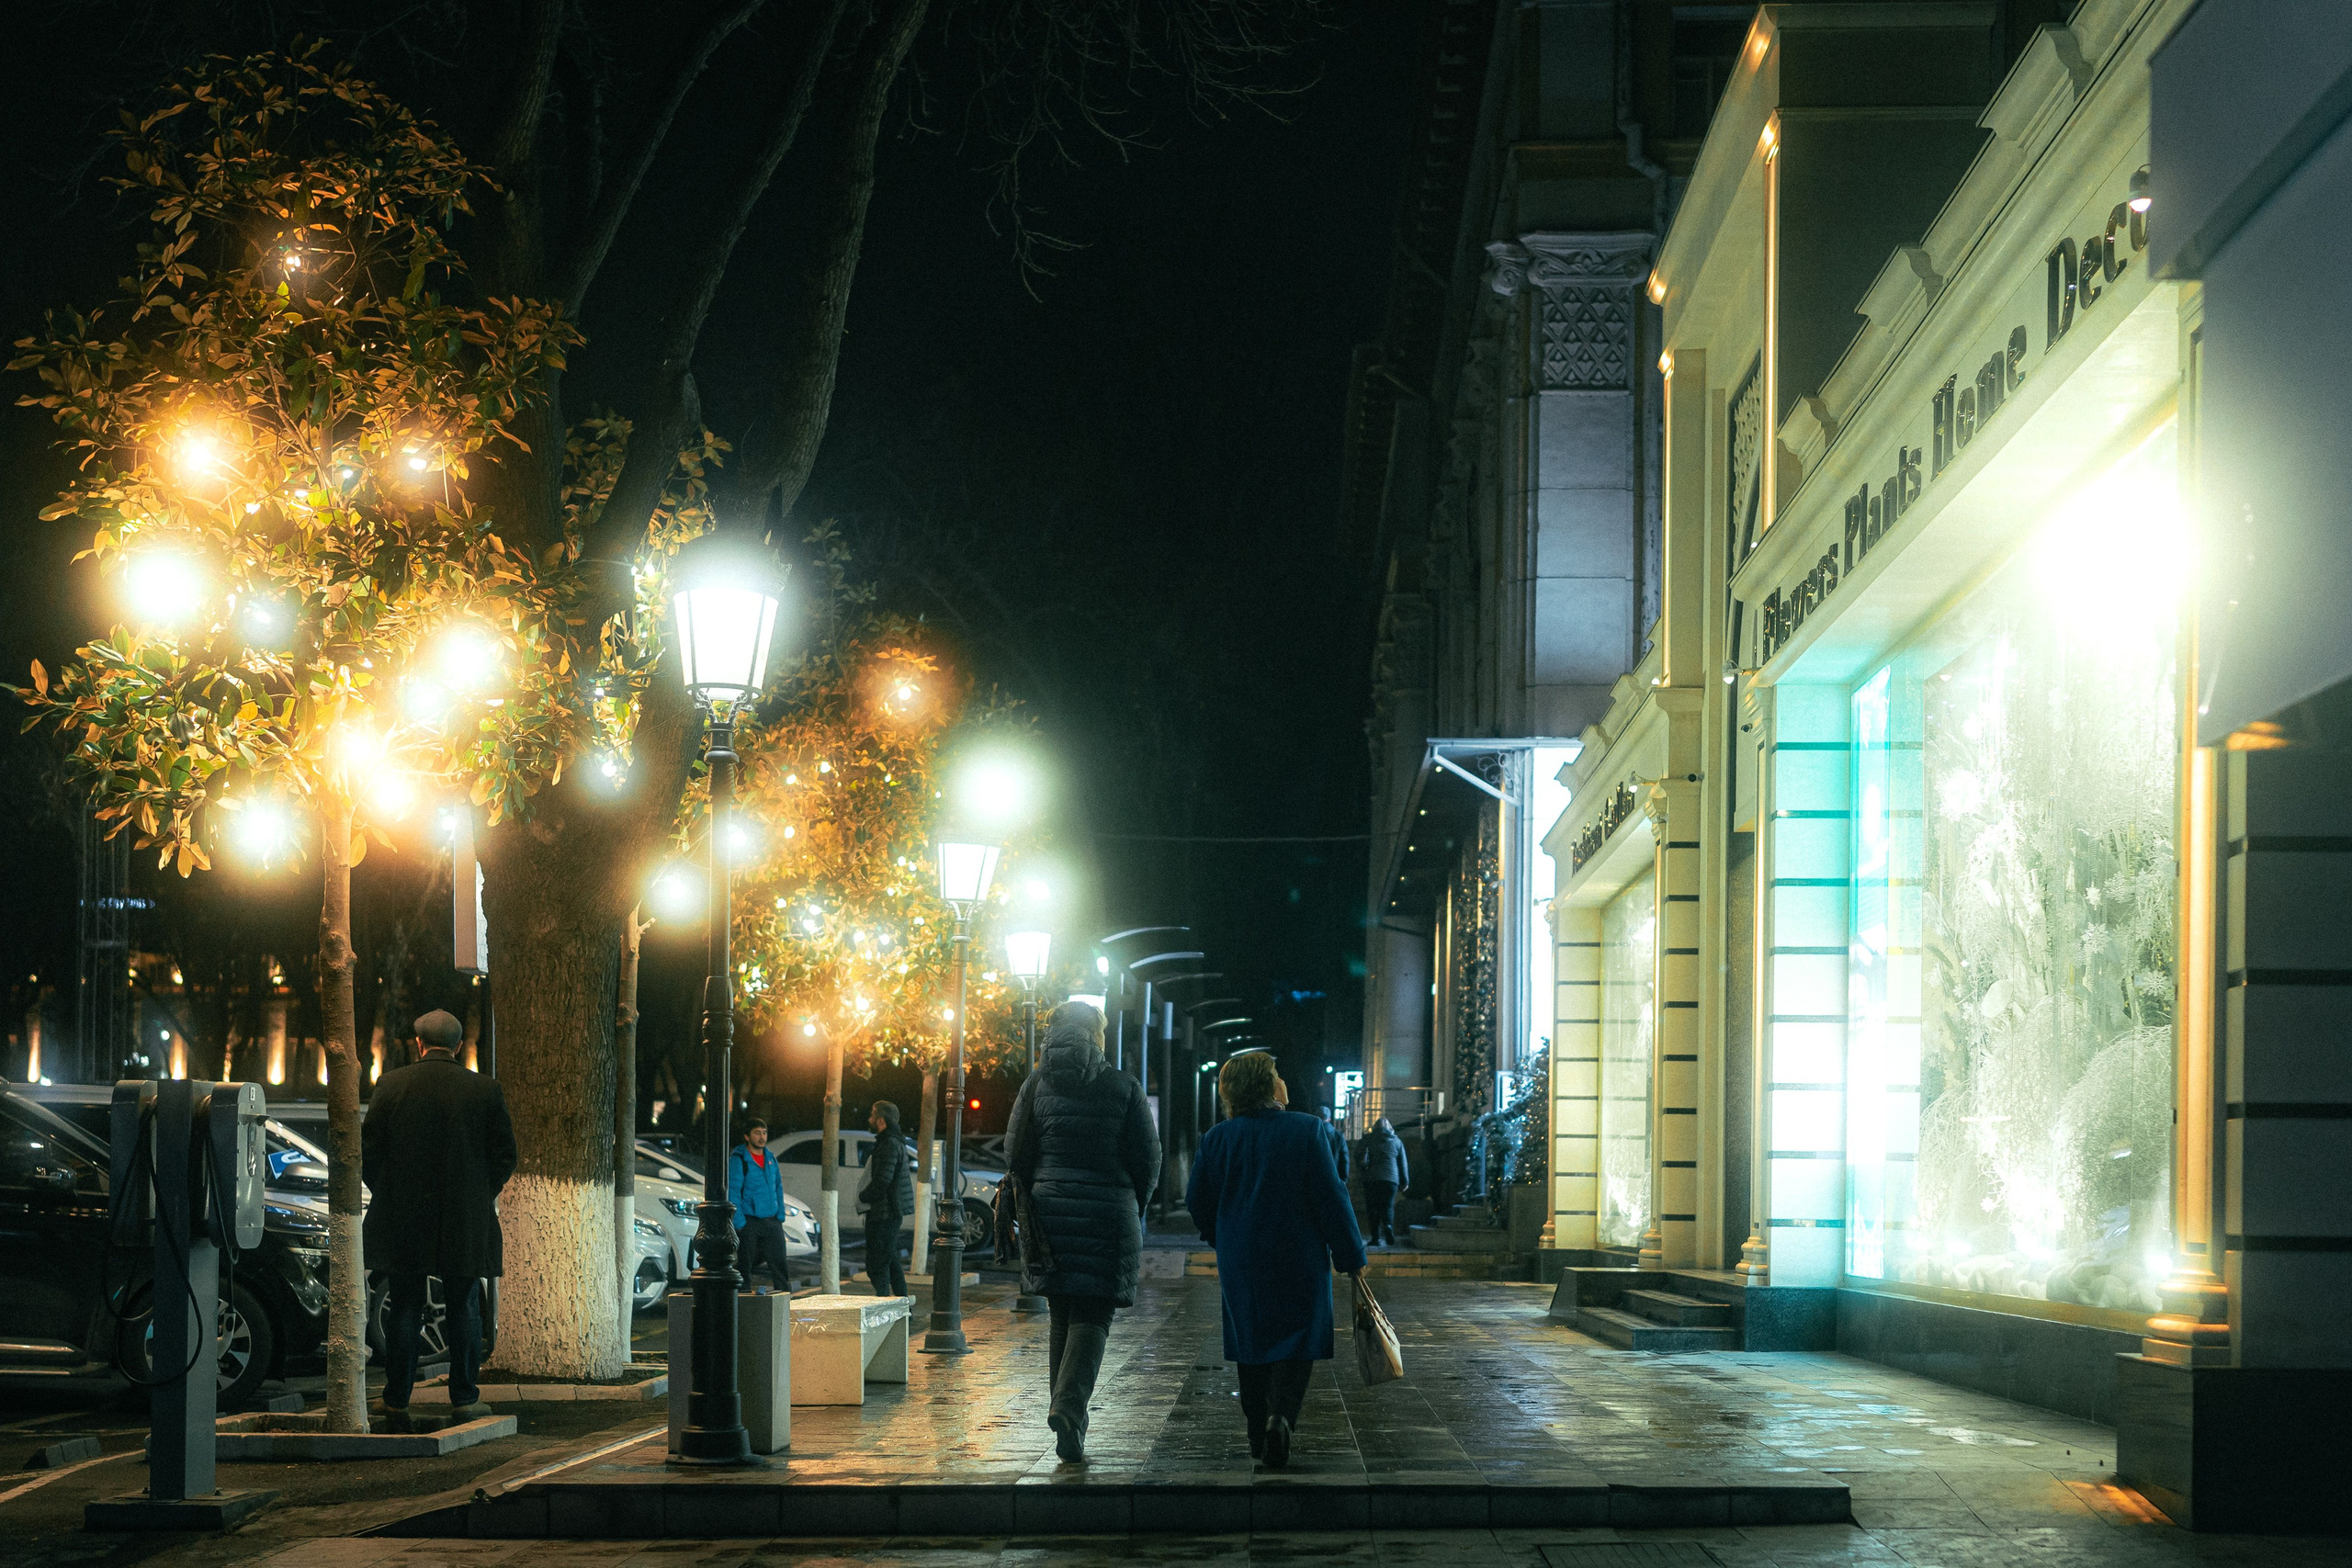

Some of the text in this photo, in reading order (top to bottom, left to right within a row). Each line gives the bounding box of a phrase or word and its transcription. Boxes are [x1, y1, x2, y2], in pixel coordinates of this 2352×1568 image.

[1762, 543, 1838, 666] Flowers
[1843, 446, 1922, 578] Plants
[1930, 324, 2027, 482] Home
